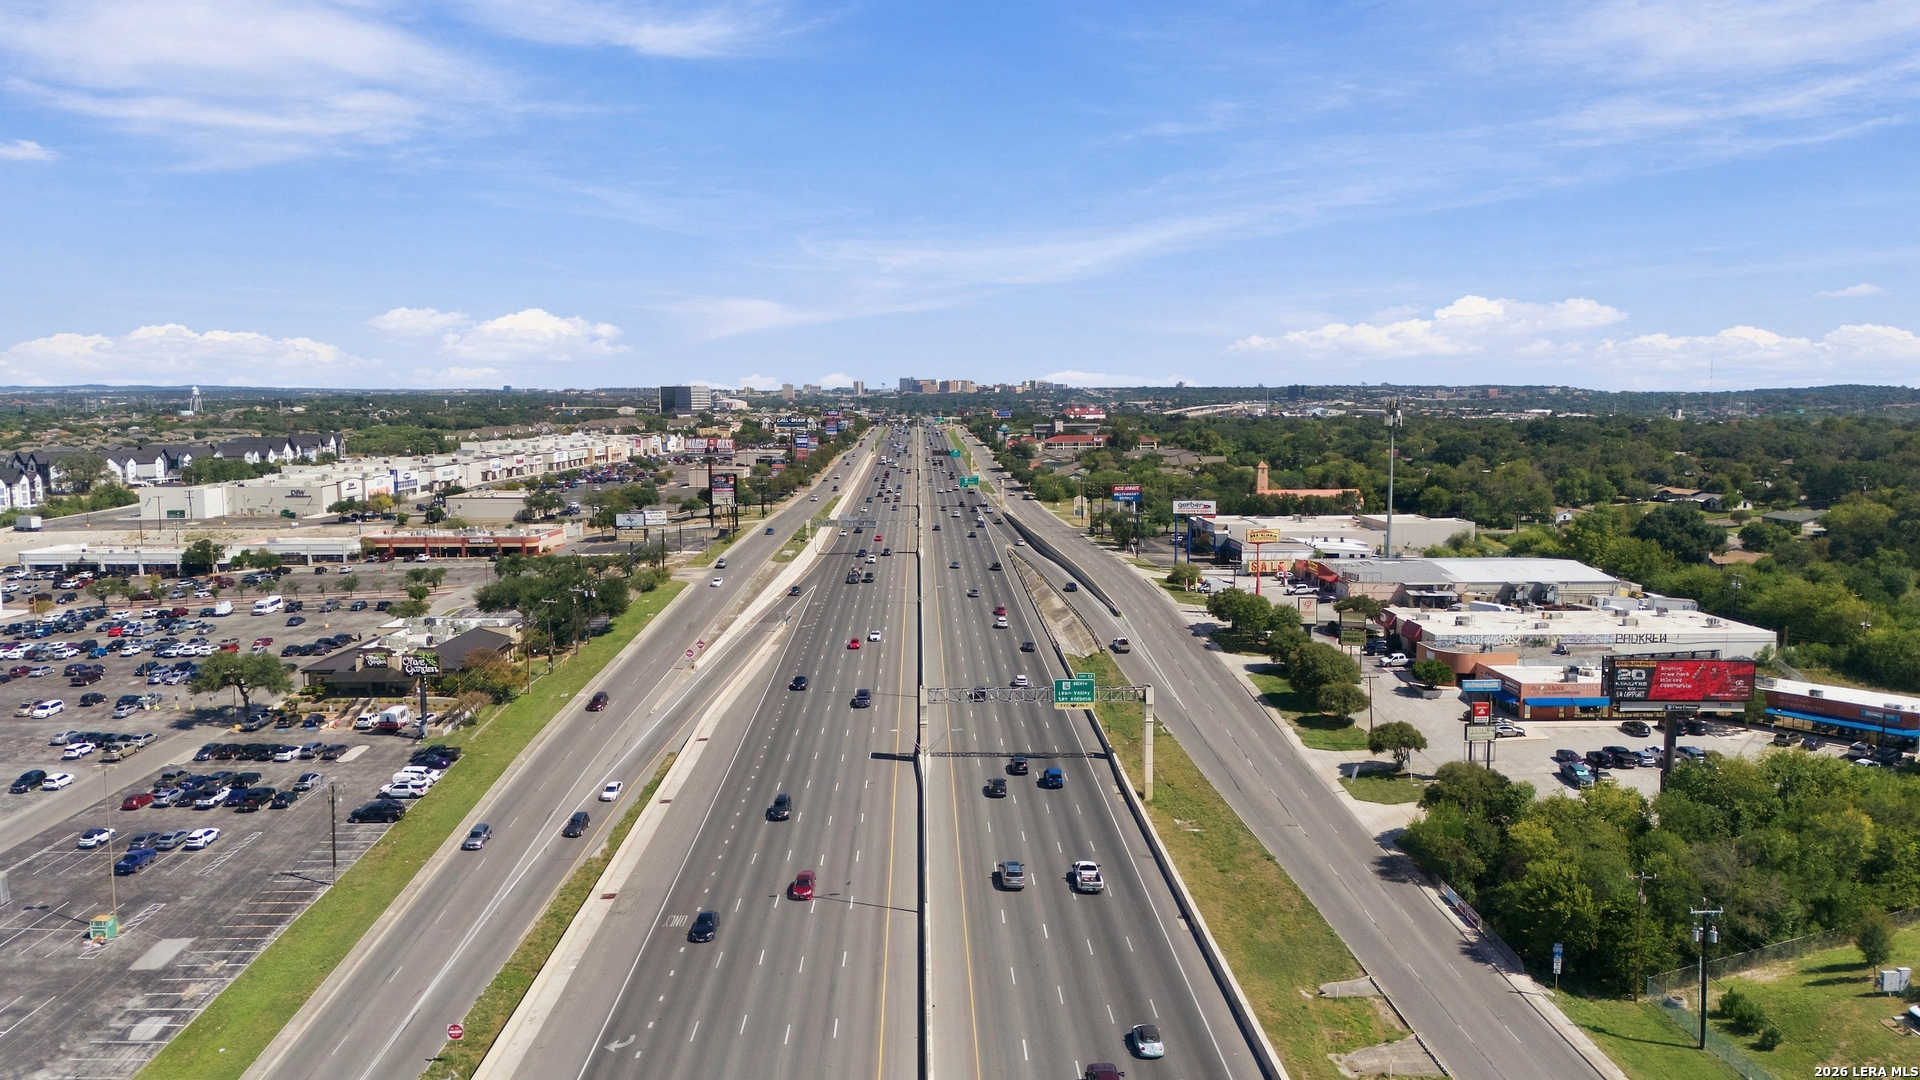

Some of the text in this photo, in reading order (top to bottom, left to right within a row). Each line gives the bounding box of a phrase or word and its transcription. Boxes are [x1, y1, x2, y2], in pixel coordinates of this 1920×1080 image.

[402, 656, 426, 665] Olive
[405, 664, 439, 676] Garden
[1617, 668, 1647, 681] 20
[662, 915, 688, 927] ONLY
